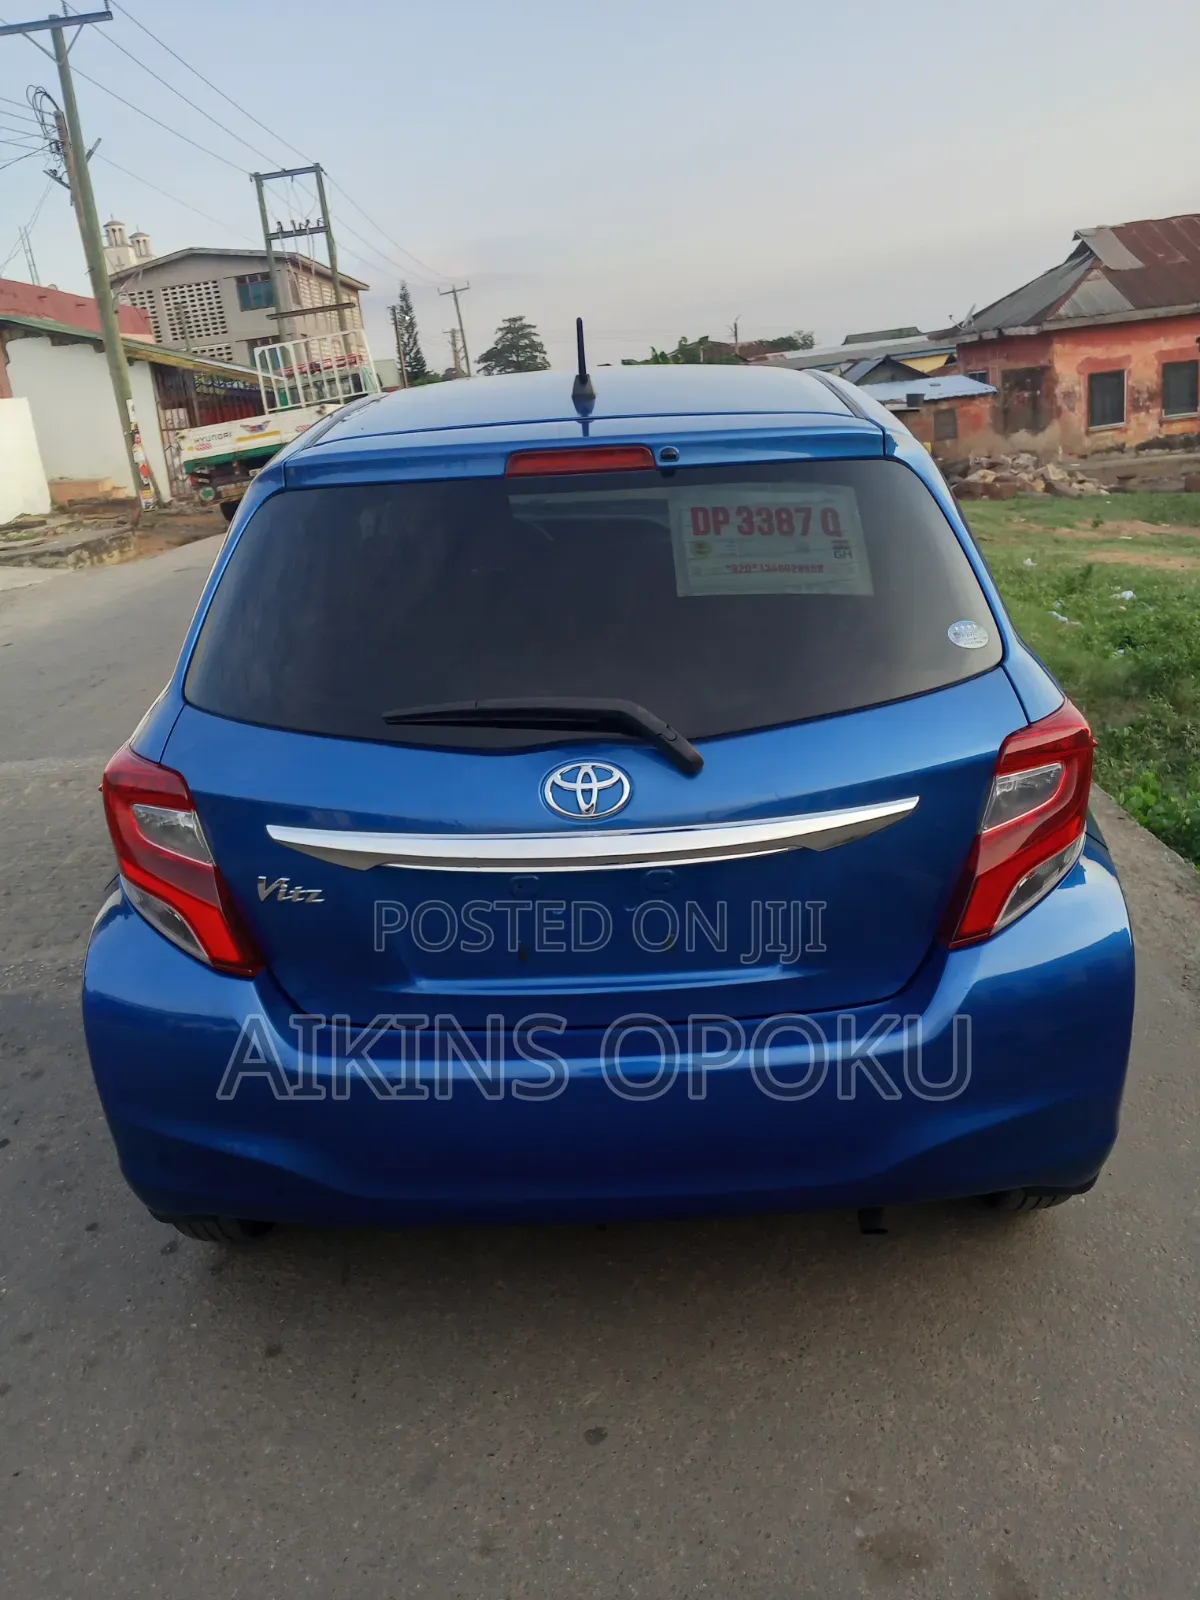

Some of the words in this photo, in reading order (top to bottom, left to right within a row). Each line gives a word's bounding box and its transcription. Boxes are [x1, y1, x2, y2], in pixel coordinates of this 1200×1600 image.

[690, 506, 730, 536] DP
[736, 506, 812, 536] 3387
[820, 507, 844, 538] Q
[257, 875, 325, 903] Vitz
